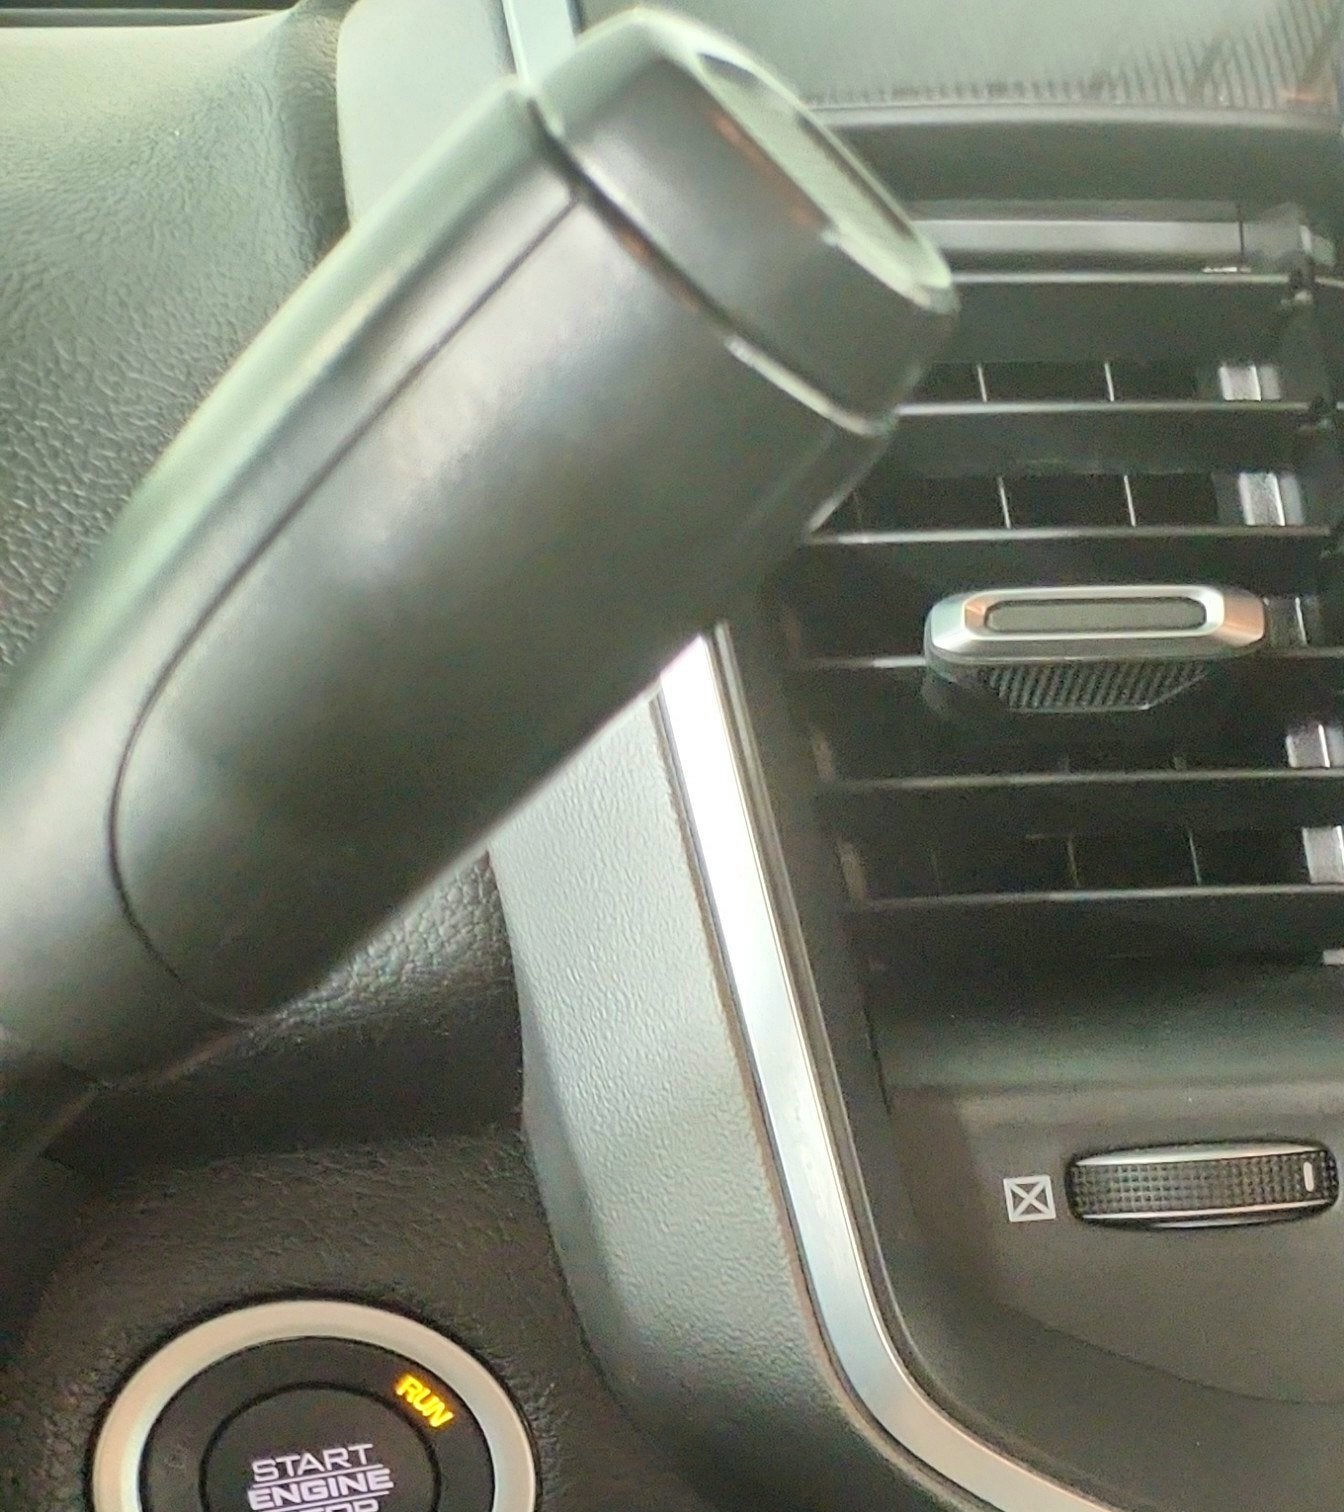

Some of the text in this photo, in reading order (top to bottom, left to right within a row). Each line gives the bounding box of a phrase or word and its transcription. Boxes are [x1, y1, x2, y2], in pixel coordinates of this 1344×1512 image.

[395, 1373, 455, 1429] RUN
[251, 1443, 374, 1483] START
[247, 1468, 395, 1512] ENGINE
